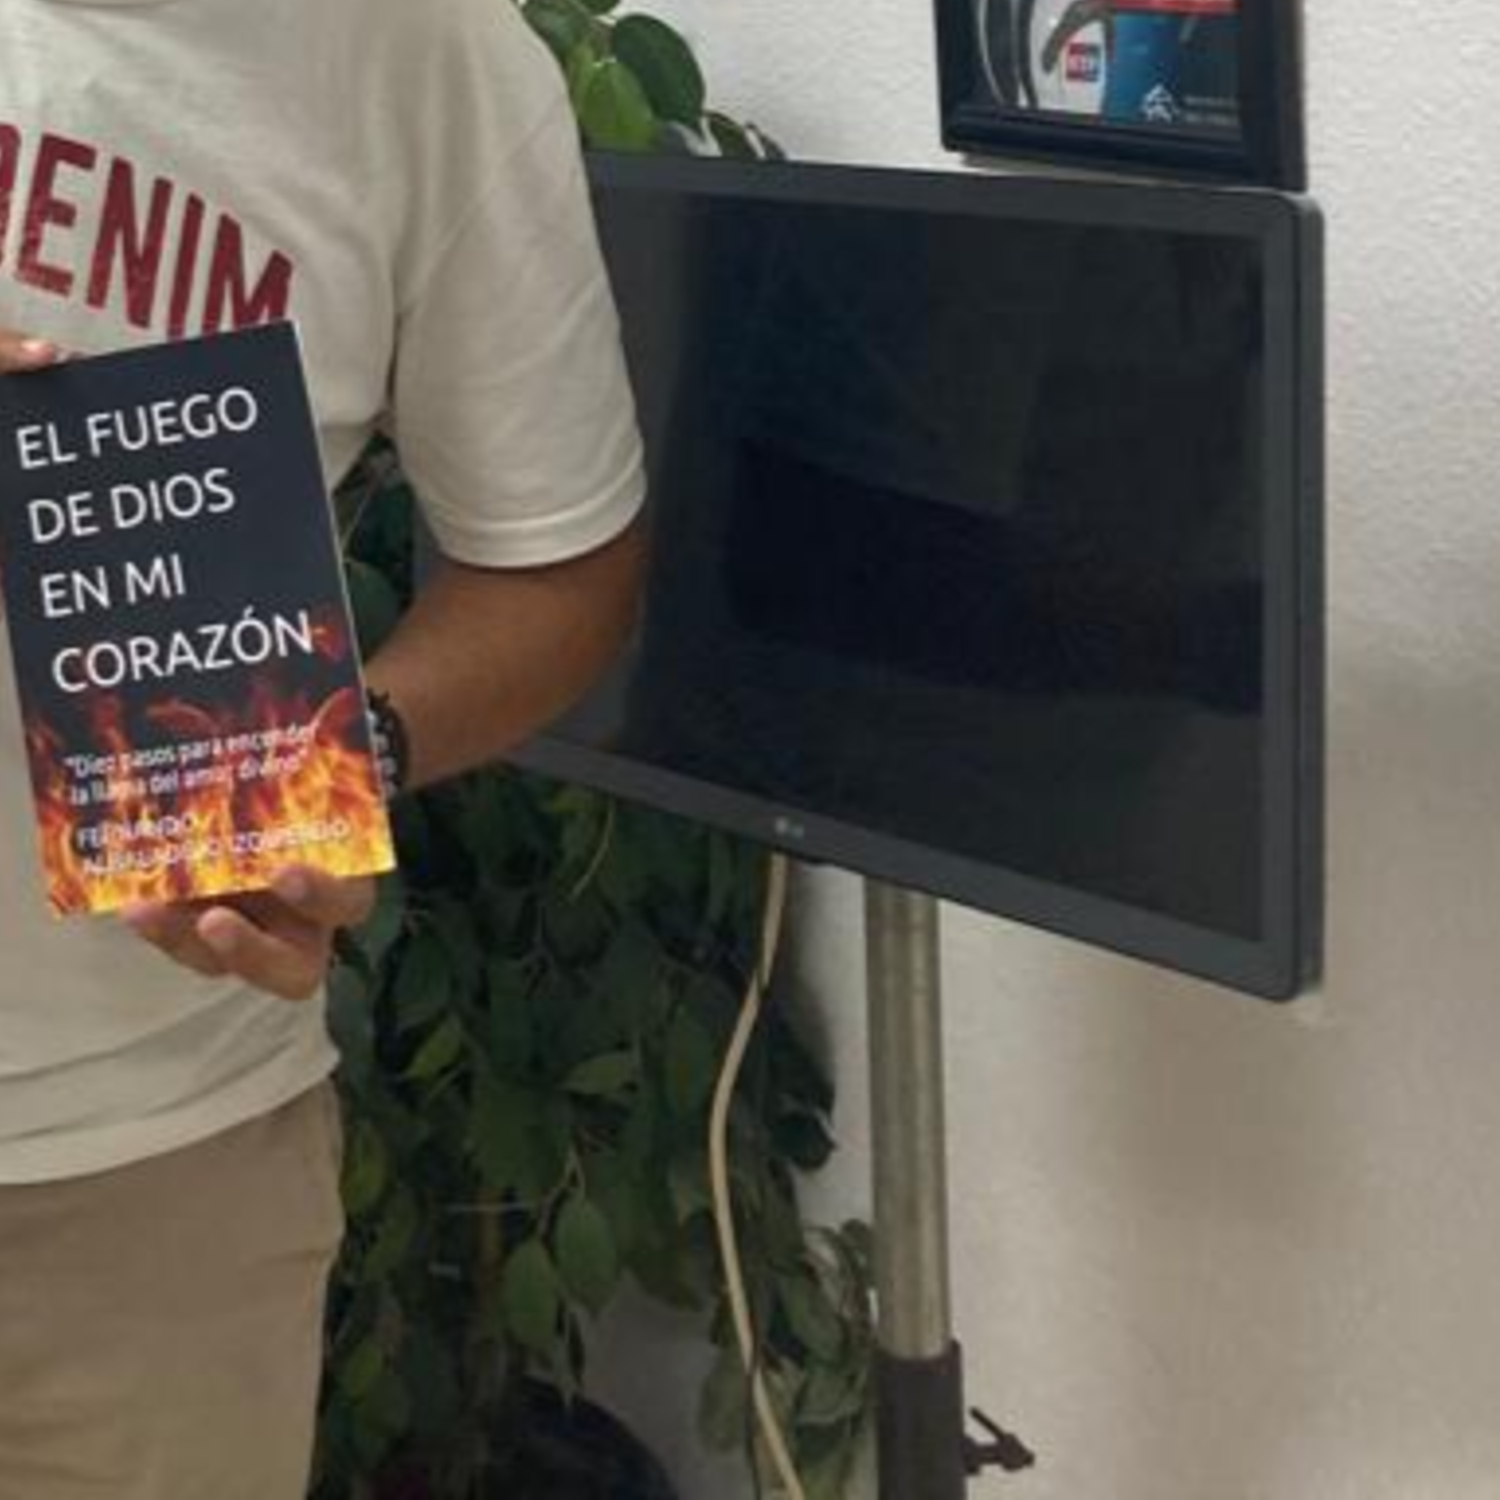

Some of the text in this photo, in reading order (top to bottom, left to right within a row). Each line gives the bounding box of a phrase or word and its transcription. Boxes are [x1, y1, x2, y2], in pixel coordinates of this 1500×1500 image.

[16, 388, 258, 470] EL FUEGO
[29, 469, 236, 543] DE DIOS
[41, 554, 186, 618] EN MI
[52, 606, 315, 693] CORAZÓN
[179, 739, 222, 767] para
[71, 785, 90, 805] la
[150, 772, 178, 795] del
